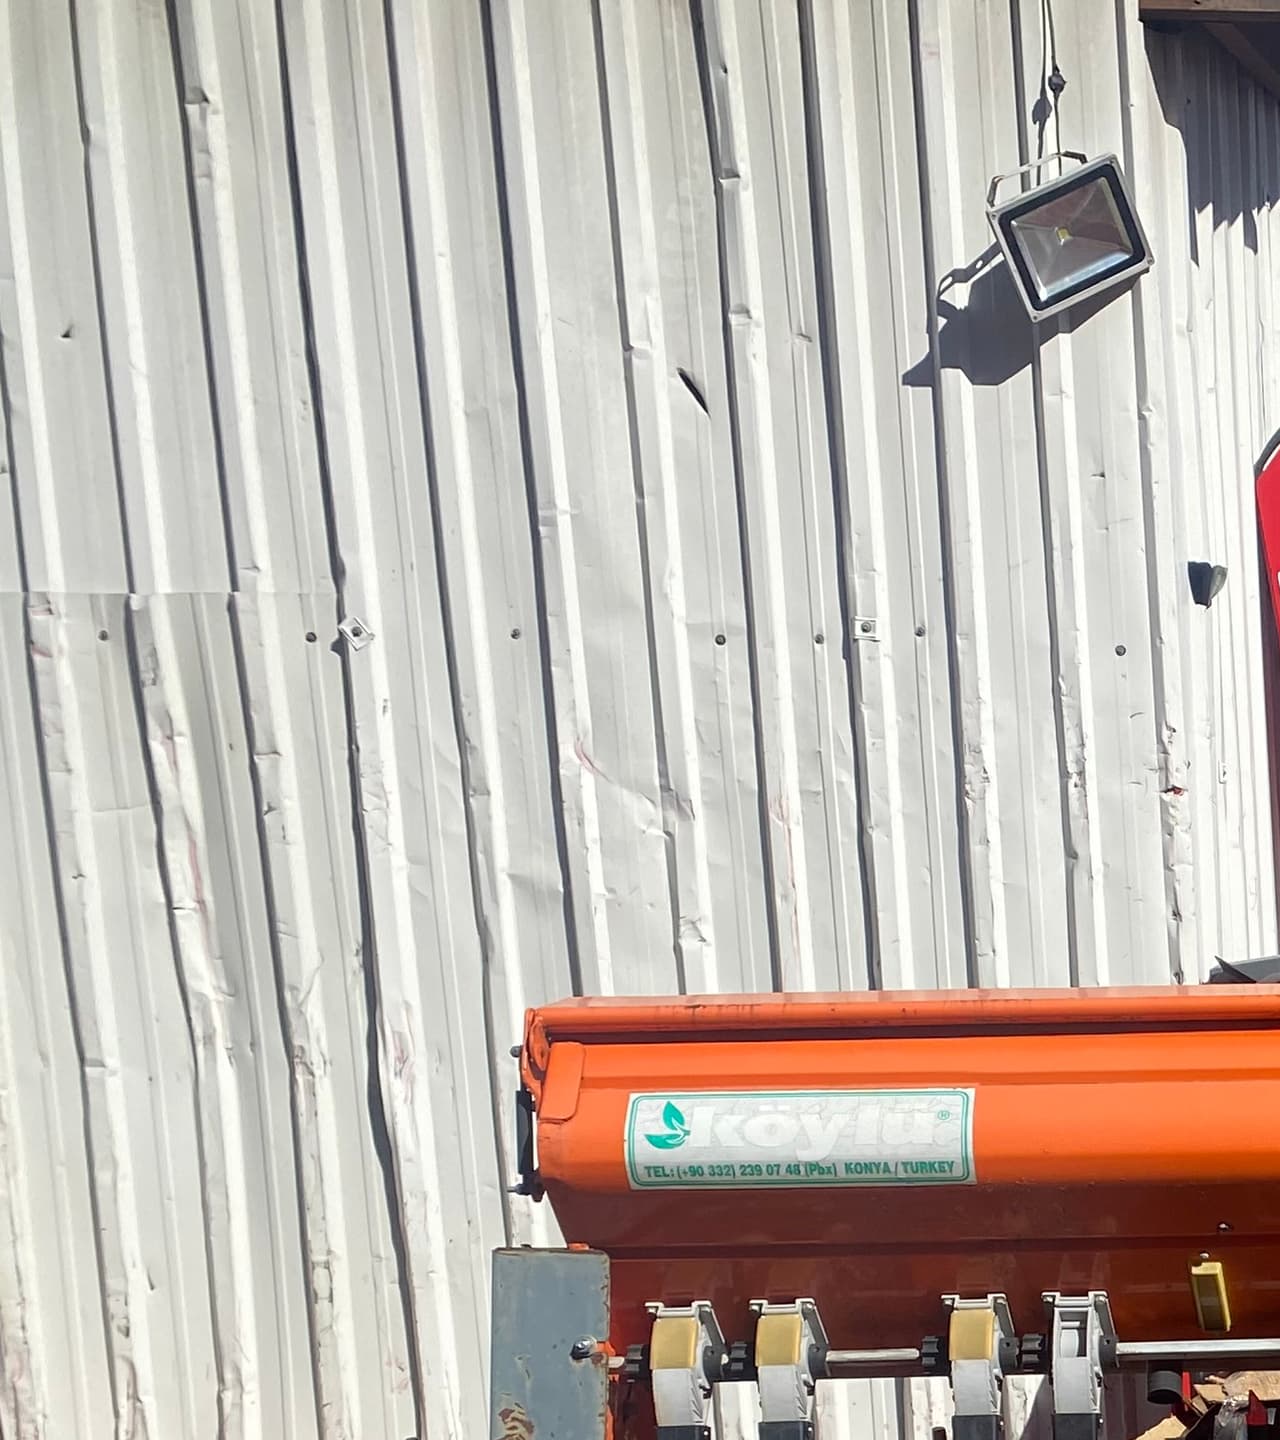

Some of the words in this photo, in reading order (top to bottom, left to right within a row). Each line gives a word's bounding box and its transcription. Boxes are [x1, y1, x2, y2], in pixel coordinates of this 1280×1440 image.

[644, 1166, 675, 1178] TEL:
[707, 1164, 736, 1179] 332)
[739, 1164, 763, 1177] 239
[766, 1164, 781, 1176] 07
[844, 1162, 891, 1175] KONYA
[902, 1160, 955, 1175] TURKEY
